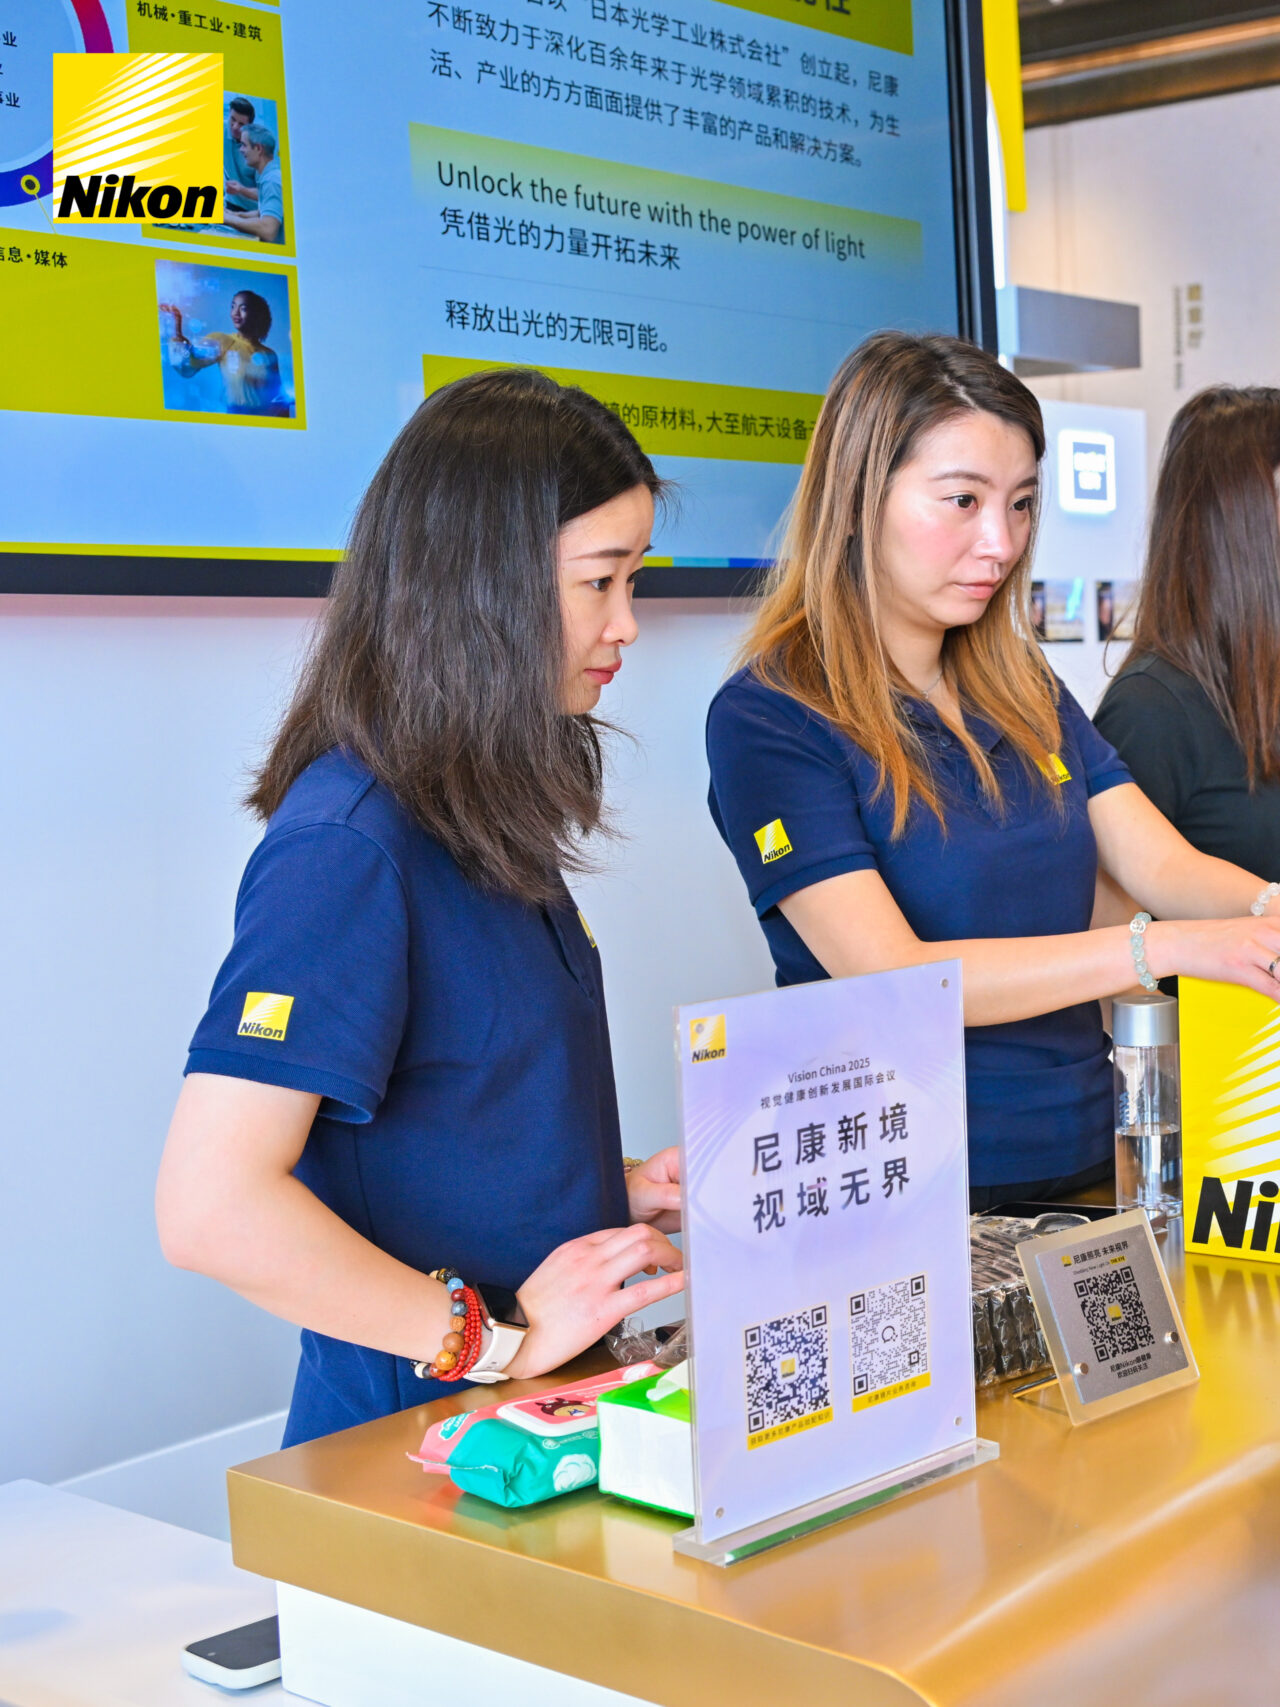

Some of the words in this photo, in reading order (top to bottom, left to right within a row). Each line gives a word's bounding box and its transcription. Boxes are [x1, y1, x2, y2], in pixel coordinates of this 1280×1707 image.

[438, 160, 524, 199] Unlock
[530, 177, 567, 207] the
[574, 184, 641, 220] future
[648, 201, 693, 229] with
[699, 209, 731, 235] the
[738, 220, 797, 247] power
[802, 228, 820, 250] of
[825, 230, 866, 262] light
[440, 206, 681, 270] 凭借光的力量开拓未来
[445, 299, 667, 353] 释放出光的无限可能。
[764, 844, 791, 862] Nikon
[239, 1022, 284, 1039] Nikon
[691, 1047, 726, 1063] Nikon
[787, 1069, 818, 1085] Vision
[819, 1063, 847, 1078] China
[848, 1057, 871, 1072] 2025
[760, 1069, 897, 1110] 视觉健康创新发展国际会议
[752, 1102, 909, 1176] 尼康新境
[753, 1157, 910, 1234] 视域无界
